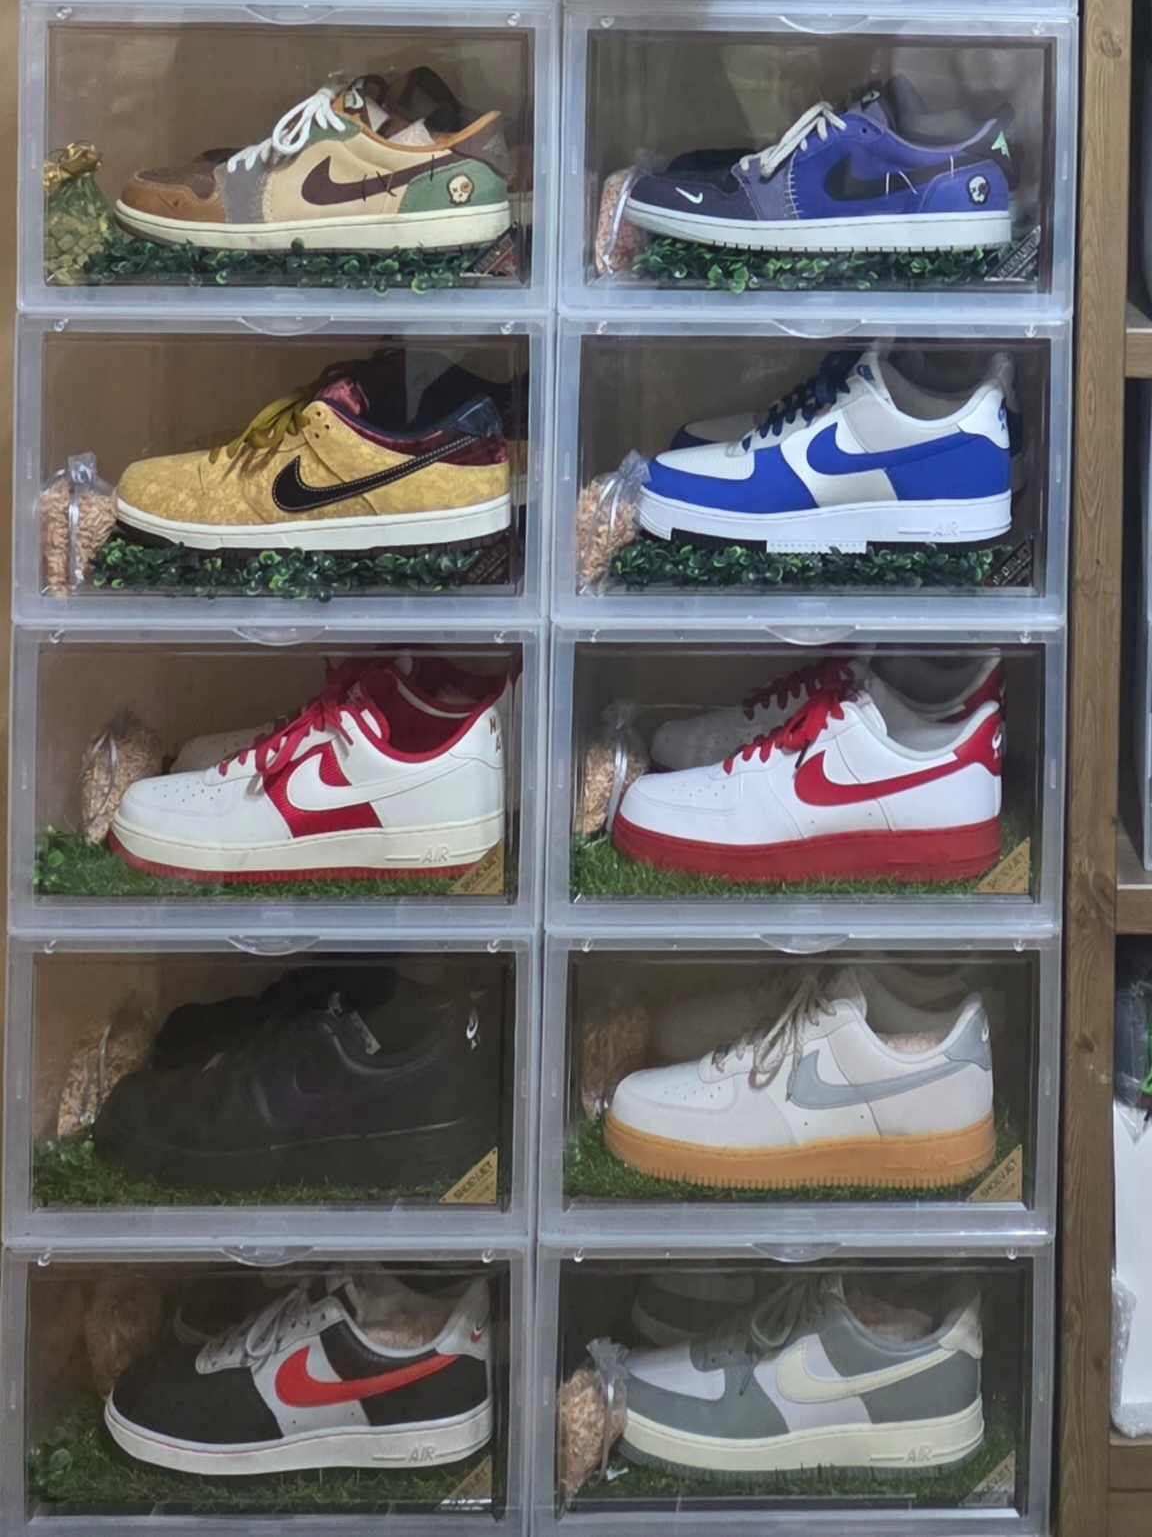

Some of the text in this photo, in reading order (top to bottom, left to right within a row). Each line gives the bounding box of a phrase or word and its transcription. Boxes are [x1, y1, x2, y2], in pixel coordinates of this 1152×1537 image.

[421, 845, 450, 864] AIR
[408, 1446, 435, 1463] AIR
[905, 1445, 933, 1463] AIR
